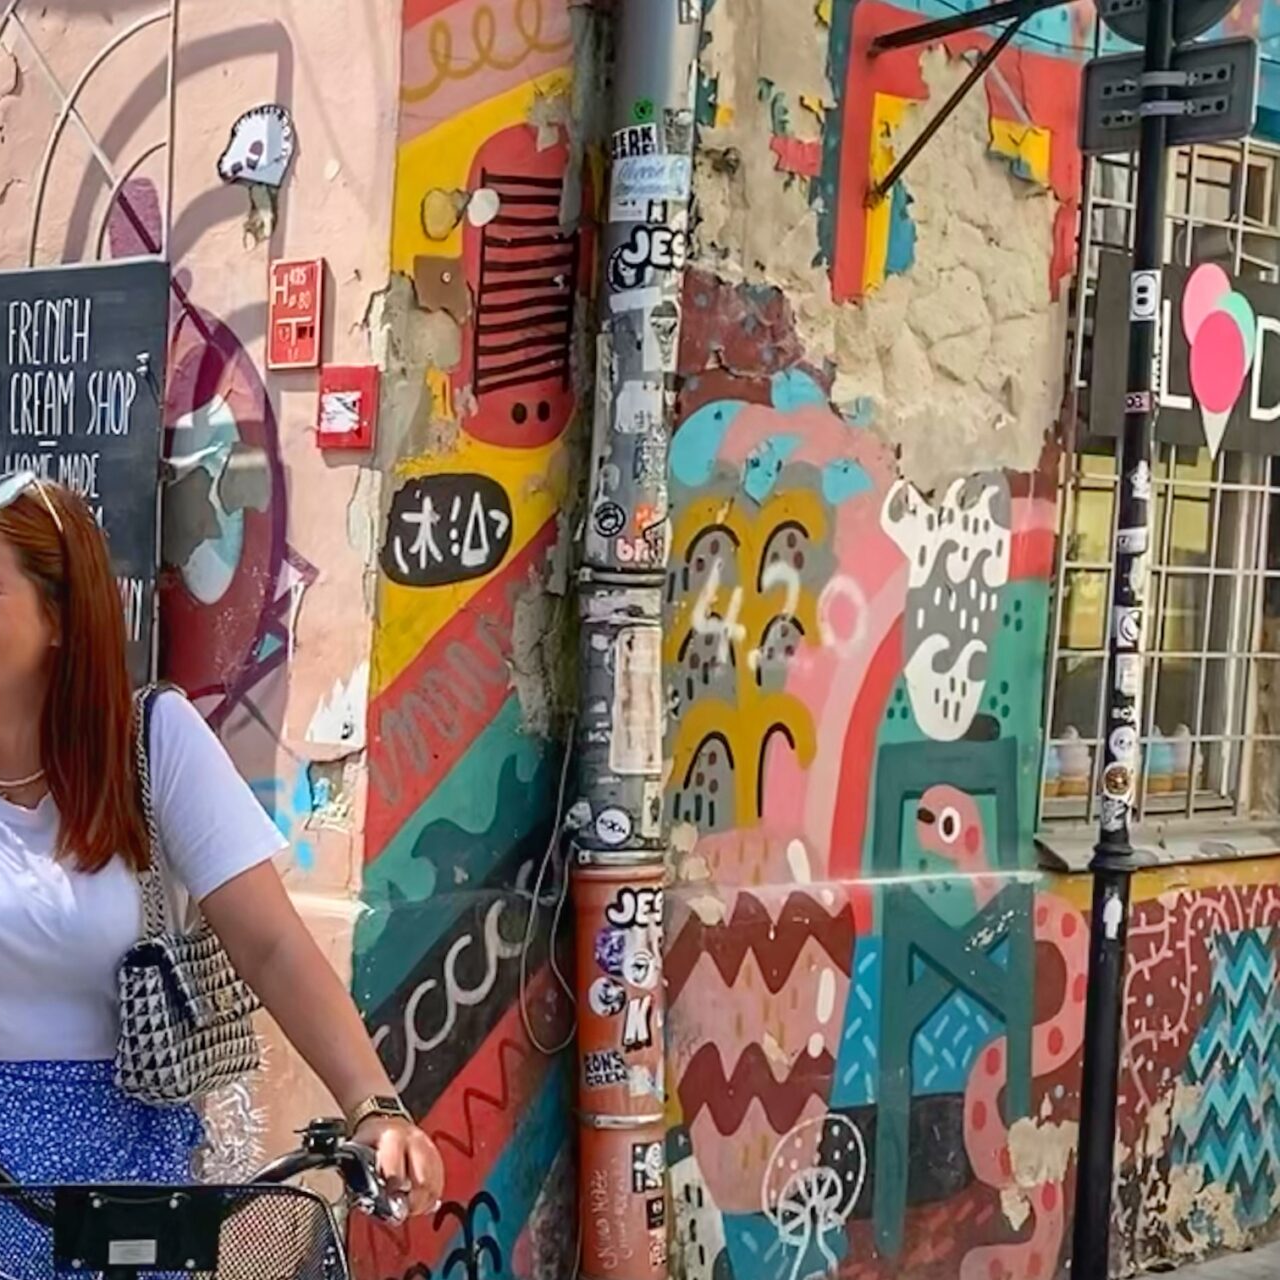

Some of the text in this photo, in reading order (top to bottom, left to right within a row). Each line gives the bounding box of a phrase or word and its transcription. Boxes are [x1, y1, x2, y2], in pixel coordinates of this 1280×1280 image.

[8, 297, 91, 365] FRENCH
[10, 369, 75, 436] CREAM
[86, 370, 137, 435] SHOP
[58, 452, 101, 498] MADE
